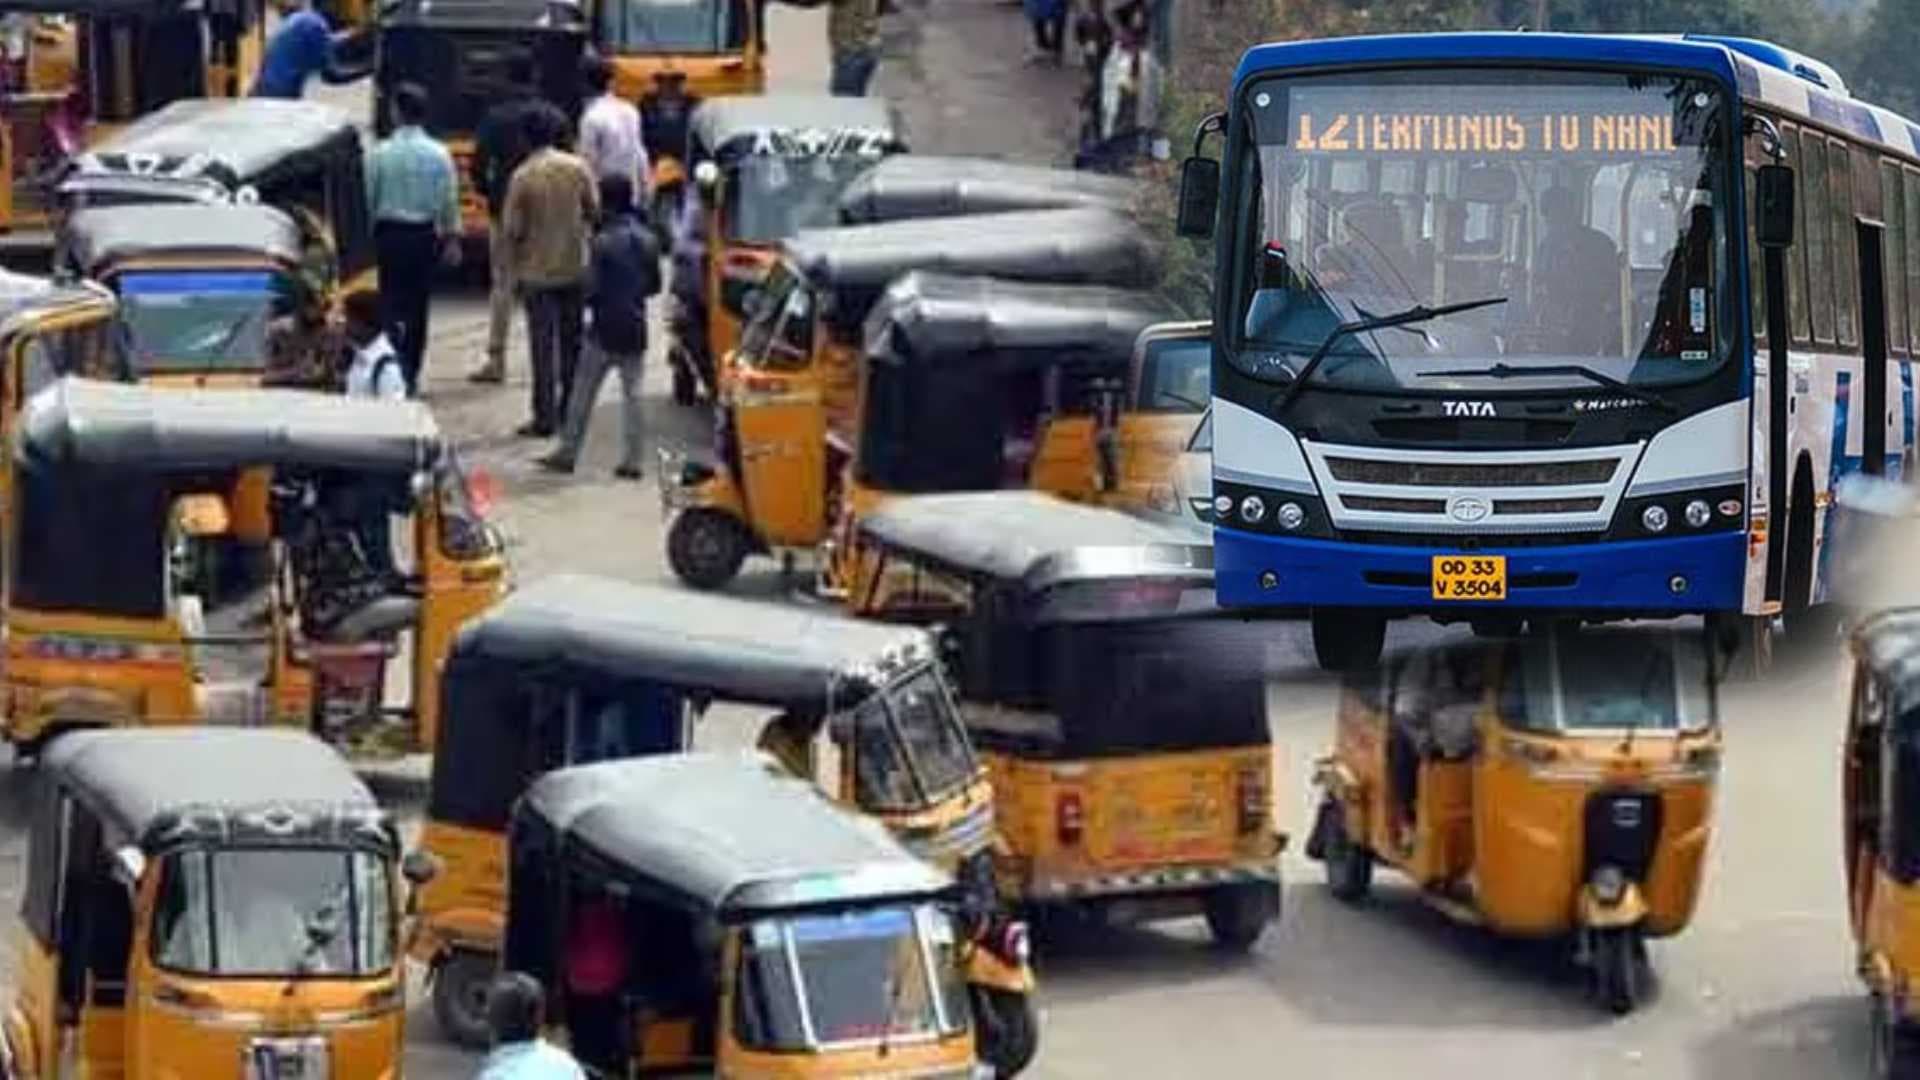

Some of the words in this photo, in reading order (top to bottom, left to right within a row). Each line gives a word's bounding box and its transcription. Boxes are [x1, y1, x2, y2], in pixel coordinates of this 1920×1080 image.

[1442, 401, 1496, 416] TATA
[1441, 560, 1466, 575] OD
[1471, 560, 1496, 575] 33
[1436, 580, 1447, 595] V
[1453, 580, 1501, 595] 3504
